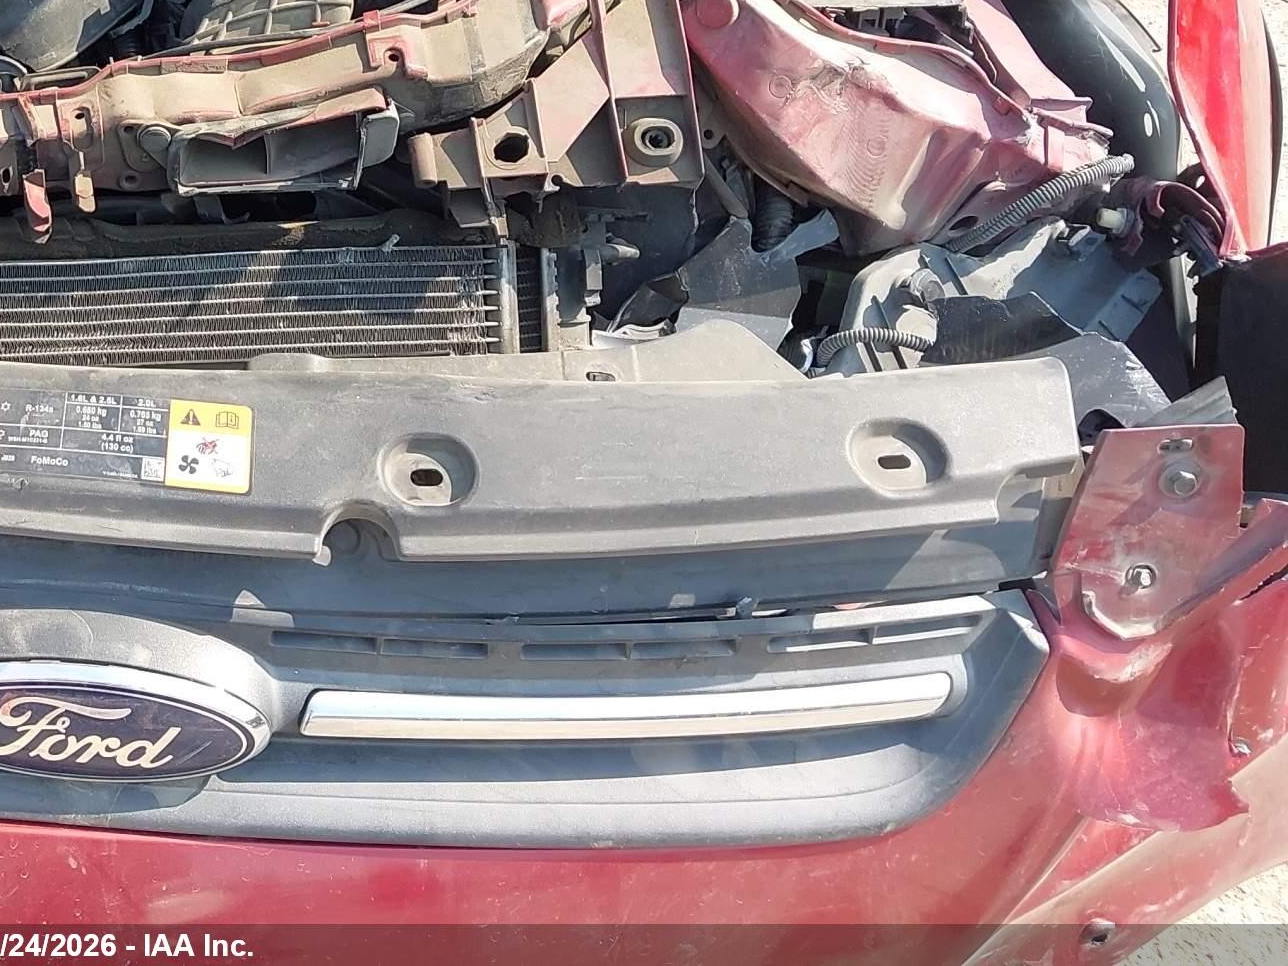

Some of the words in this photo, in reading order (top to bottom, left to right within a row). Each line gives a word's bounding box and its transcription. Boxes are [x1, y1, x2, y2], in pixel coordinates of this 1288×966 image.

[89, 395, 98, 403] &
[137, 398, 157, 408] 2.0L
[25, 403, 54, 414] R-134a
[97, 407, 108, 418] kg
[151, 411, 162, 422] kg
[29, 429, 49, 438] PAG
[101, 433, 114, 441] 4.4
[115, 434, 122, 442] fl
[101, 442, 119, 453] (130
[30, 455, 69, 467] FoMoCo
